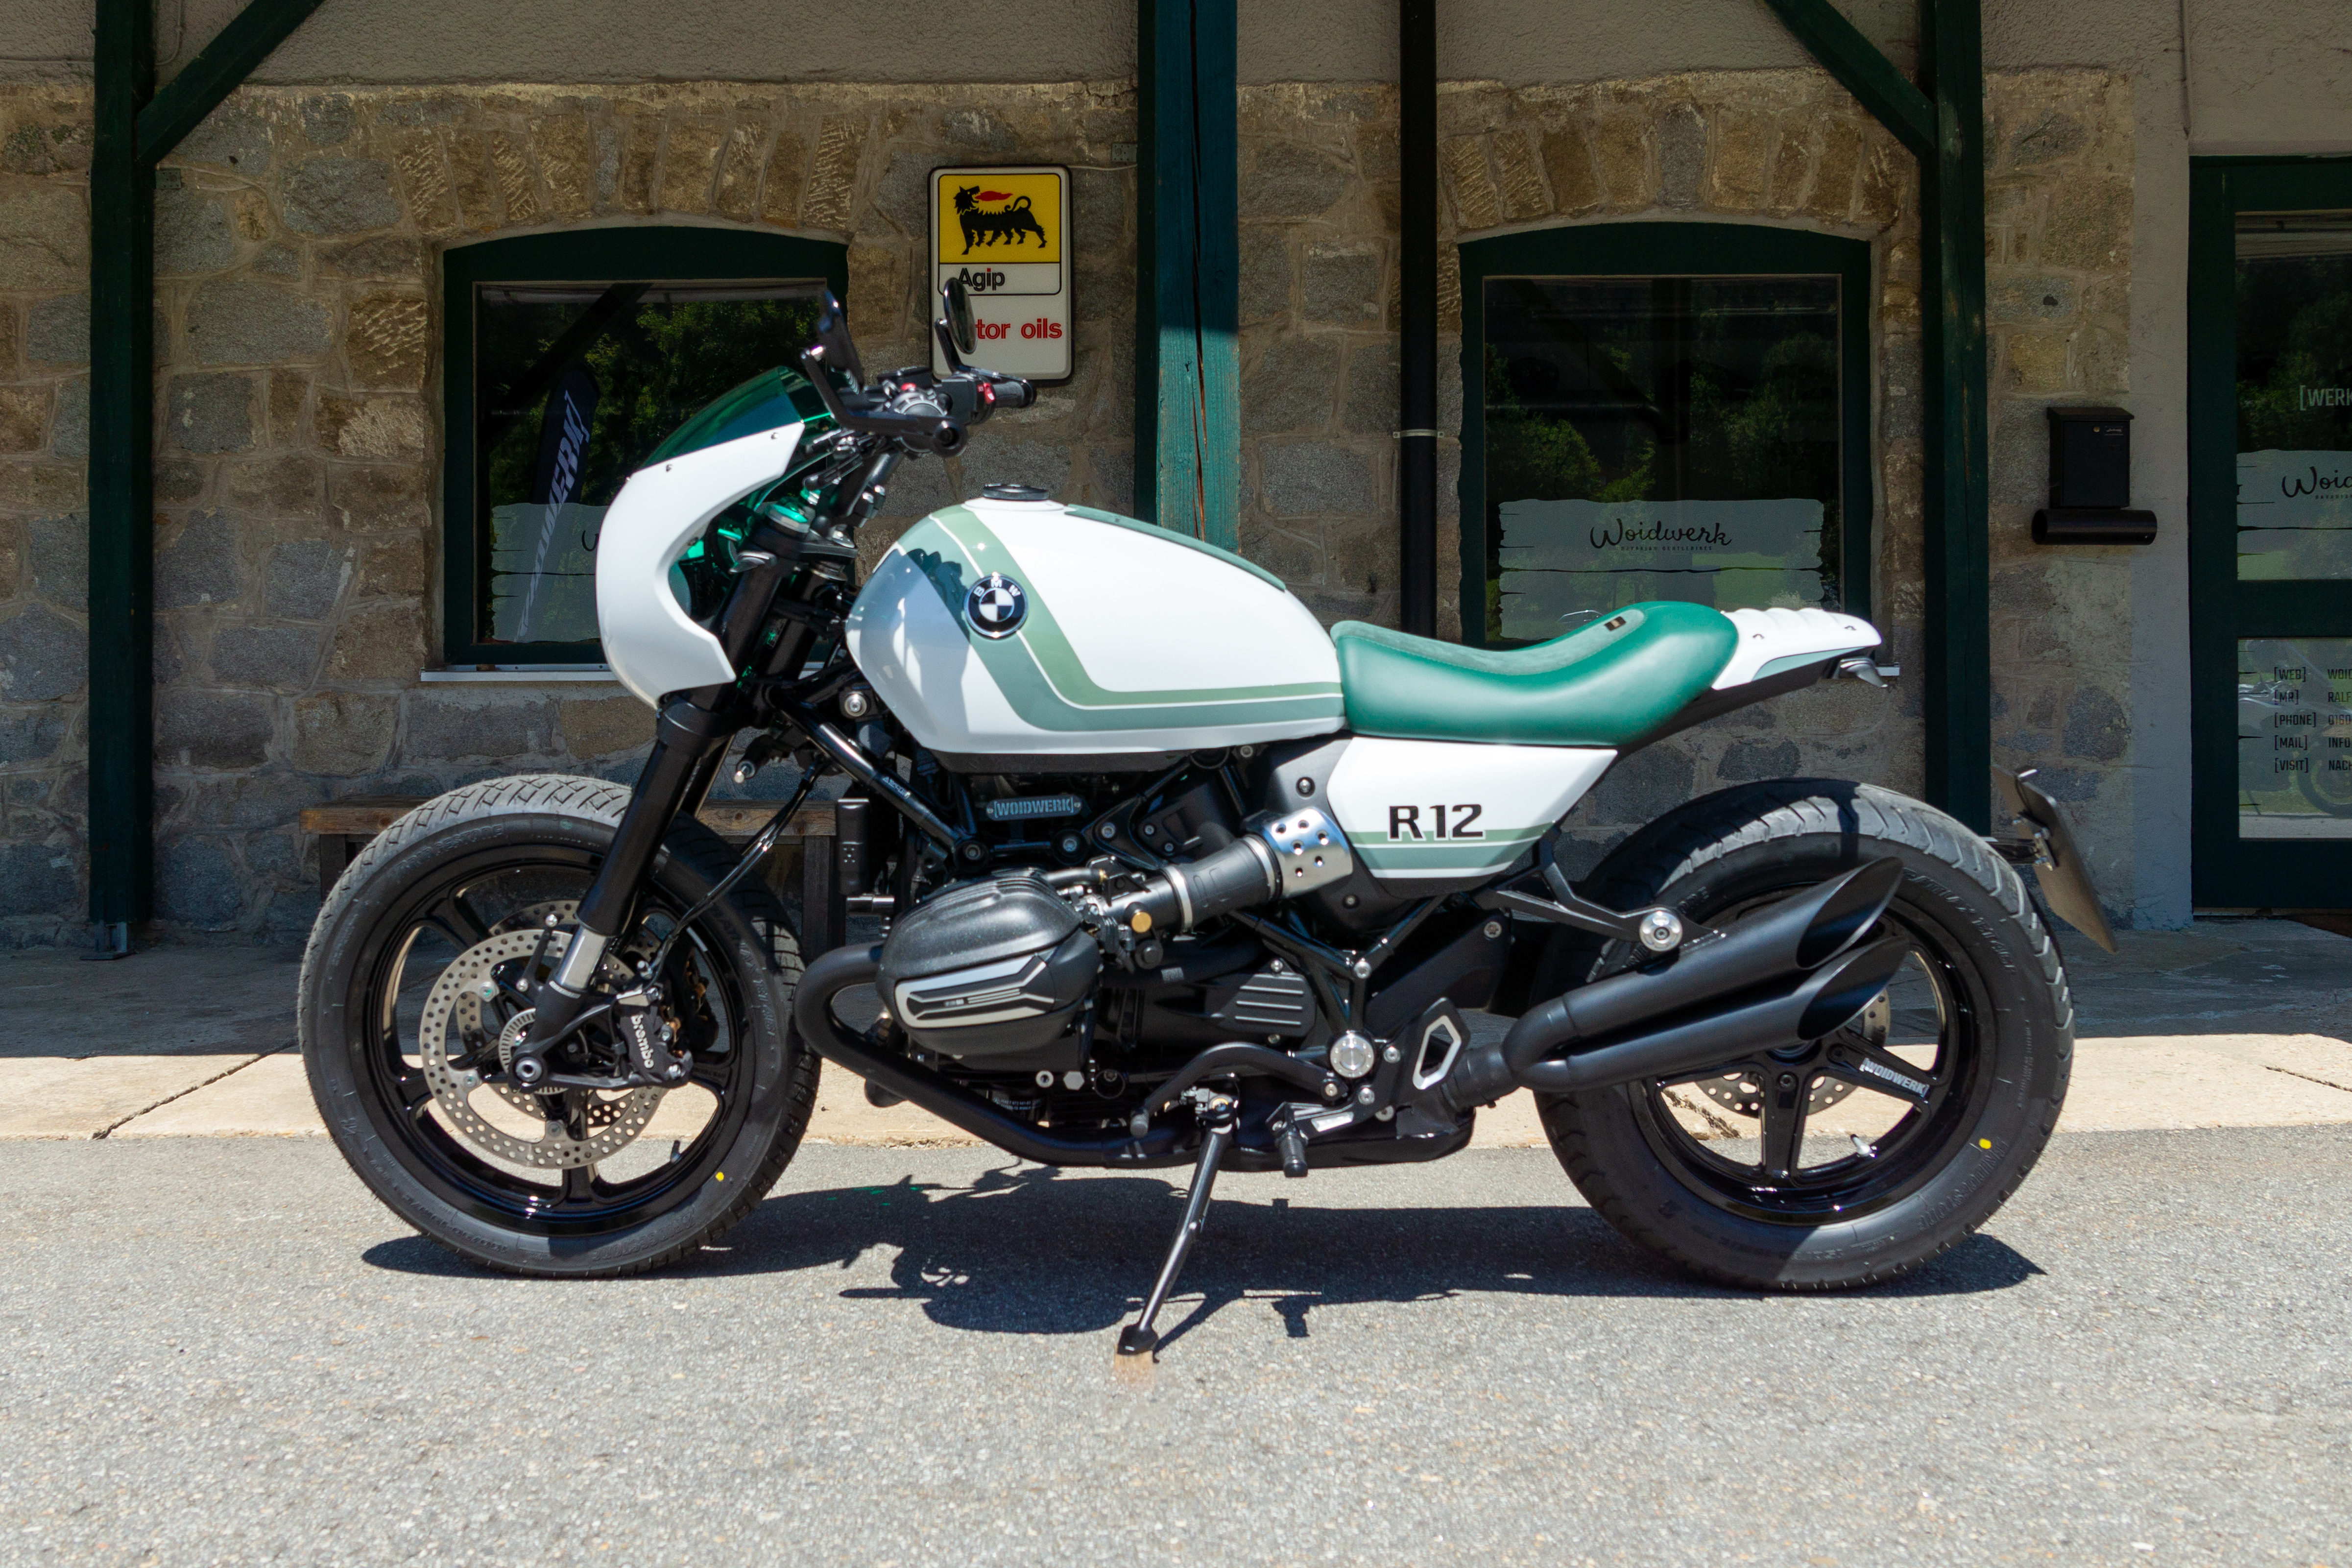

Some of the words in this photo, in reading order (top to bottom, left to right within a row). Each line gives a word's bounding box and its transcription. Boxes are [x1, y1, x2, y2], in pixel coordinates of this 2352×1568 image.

[958, 268, 1005, 290] Agip
[975, 318, 1011, 339] tor
[1021, 318, 1063, 339] oils
[1590, 518, 1732, 549] Woidwerk
[973, 579, 1021, 597] BMW
[2274, 667, 2306, 682] [WEB]
[2274, 690, 2299, 705] [MR]
[2275, 712, 2316, 727] [PHONE]
[2275, 735, 2307, 750] [MAIL]
[2328, 737, 2352, 748] INFO
[2275, 758, 2308, 773] [VISIT]
[994, 796, 1074, 818] [WOIDWERK]
[630, 1014, 655, 1069] brembo
